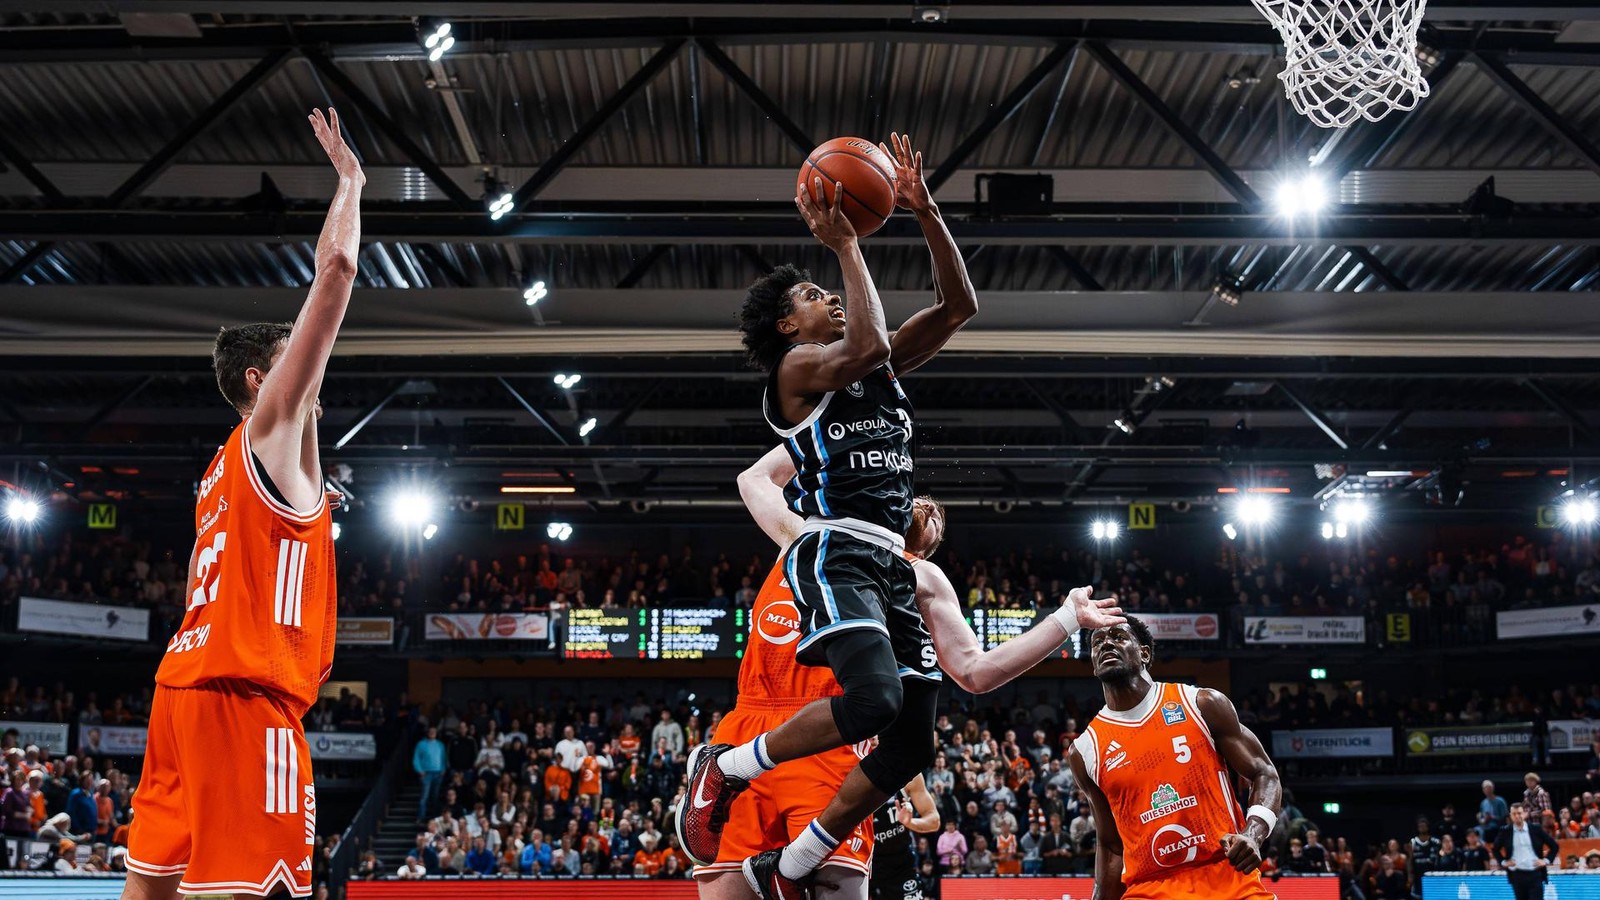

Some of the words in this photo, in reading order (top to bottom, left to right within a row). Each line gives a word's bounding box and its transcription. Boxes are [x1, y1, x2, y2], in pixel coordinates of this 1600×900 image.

[846, 419, 887, 432] VEOLIA
[895, 408, 912, 443] 3
[92, 505, 113, 524] M
[503, 507, 519, 525] N
[1134, 507, 1149, 525] N
[765, 612, 801, 630] MIAV
[1394, 615, 1404, 632] E
[921, 645, 938, 668] S
[1171, 735, 1192, 764] 5
[1432, 736, 1456, 747] DEIN
[304, 782, 317, 845] VISA
[1141, 796, 1196, 823] WIESENHOF
[874, 825, 906, 843] xperia
[1157, 833, 1207, 857] MIAVIT
